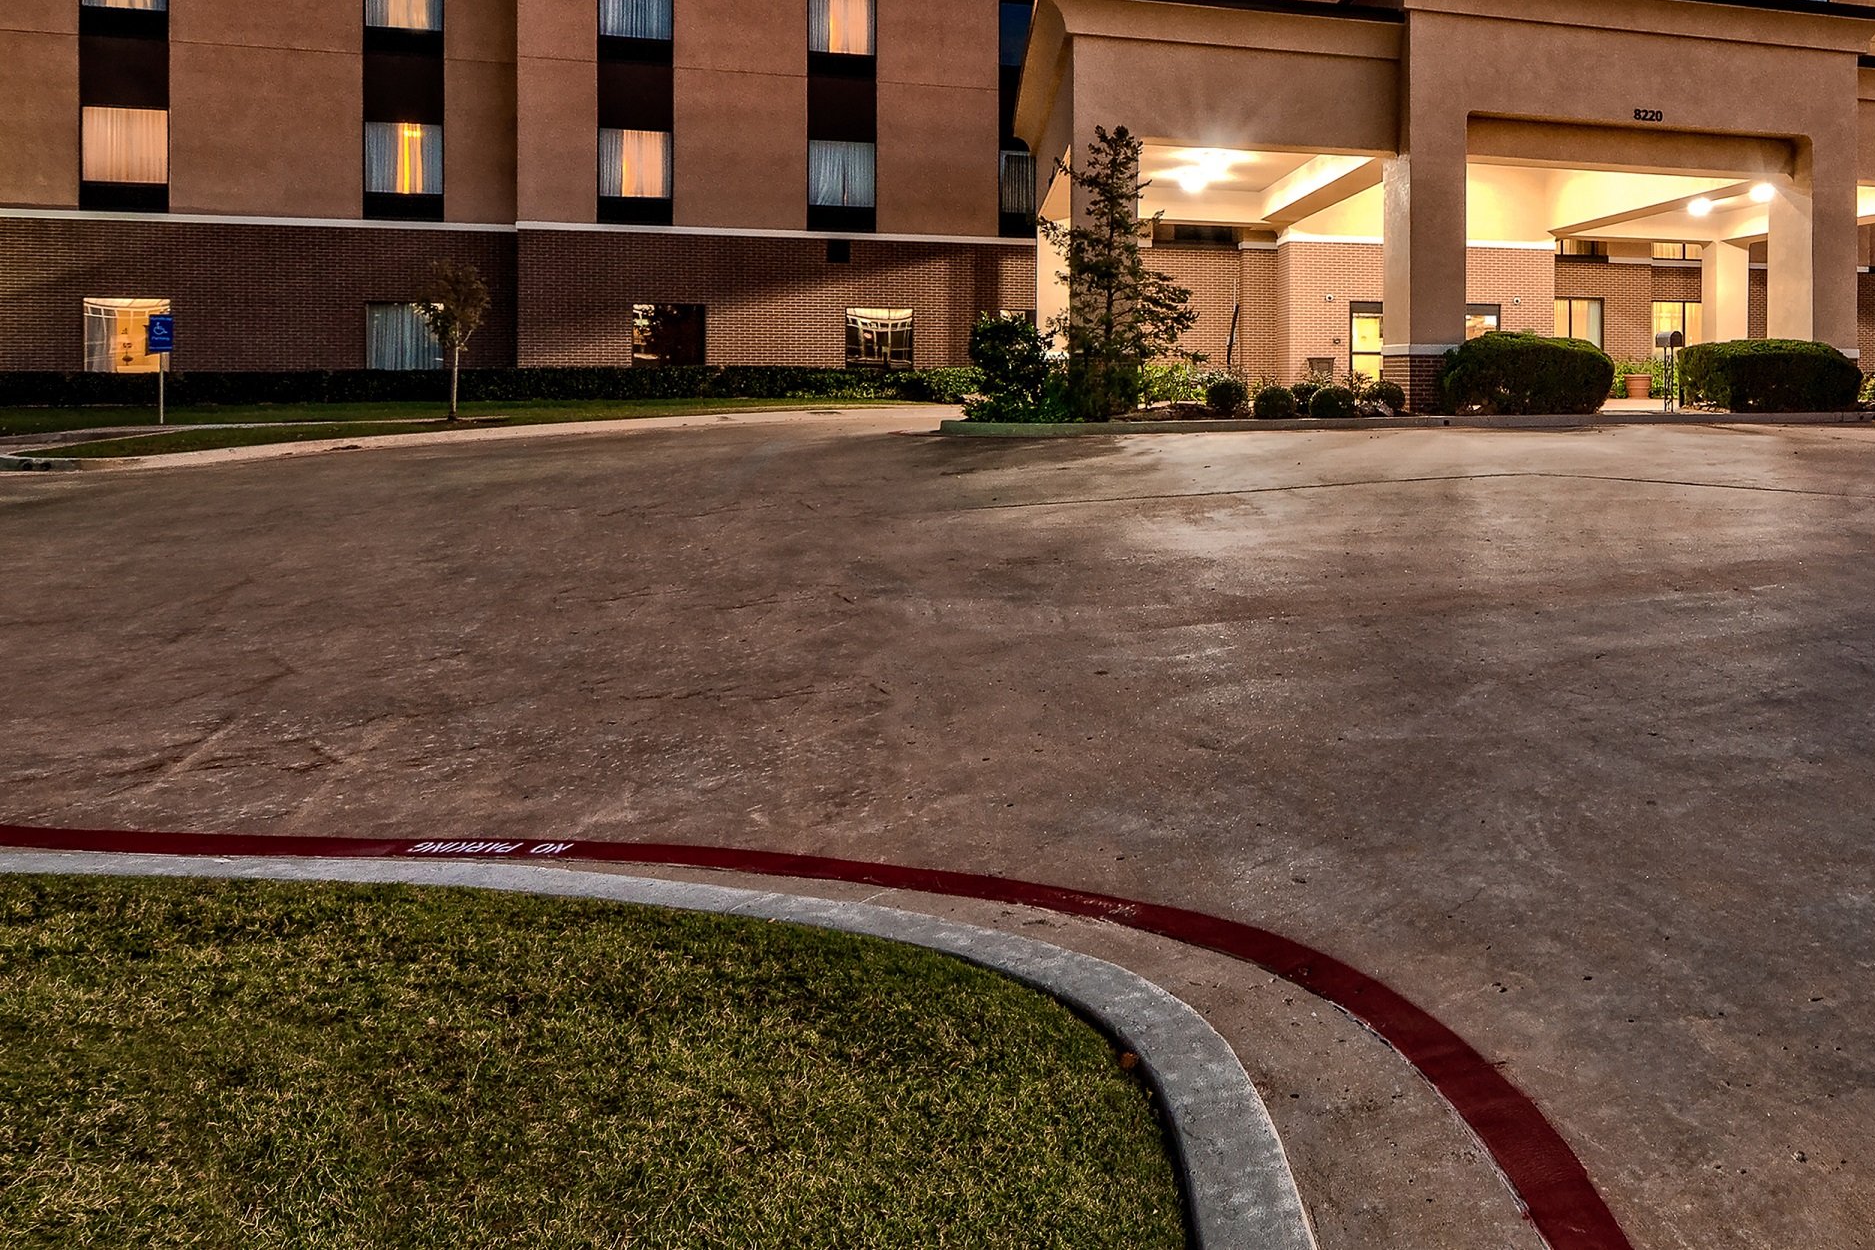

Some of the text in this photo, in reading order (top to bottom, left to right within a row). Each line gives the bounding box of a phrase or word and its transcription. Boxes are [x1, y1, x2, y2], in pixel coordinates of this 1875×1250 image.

[1633, 108, 1663, 122] 8220
[407, 841, 574, 854] NO PARKING
